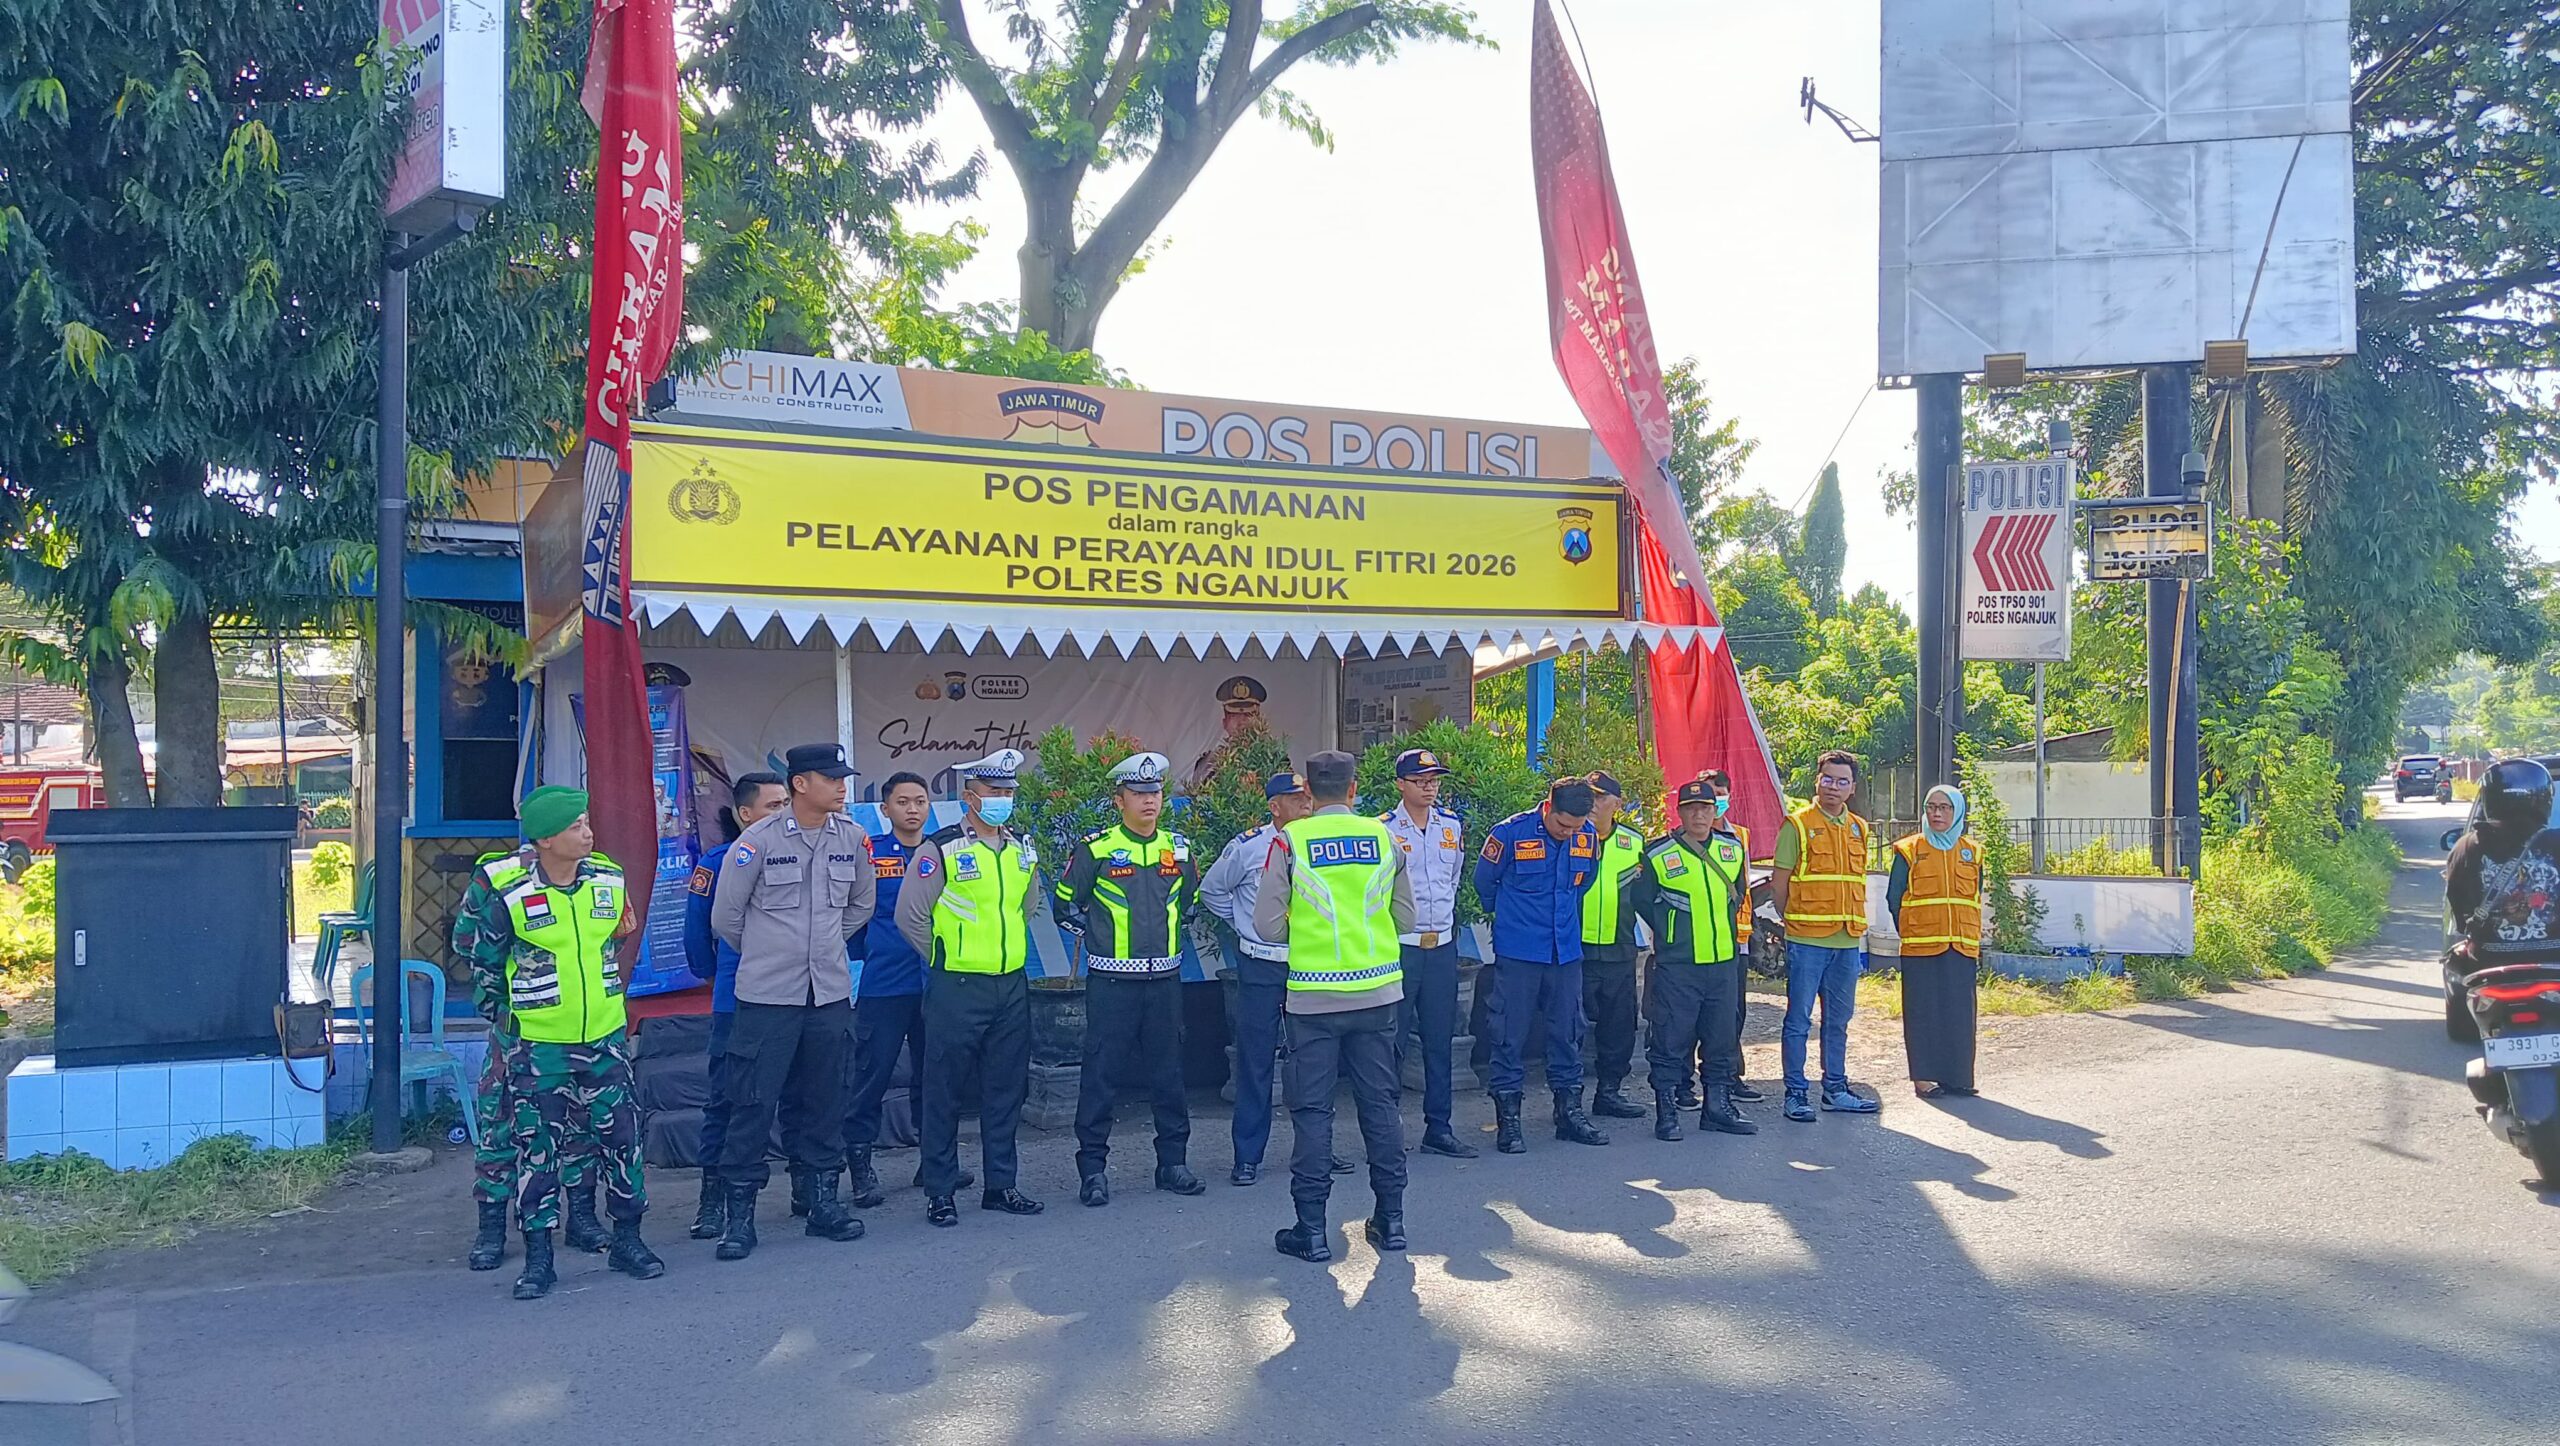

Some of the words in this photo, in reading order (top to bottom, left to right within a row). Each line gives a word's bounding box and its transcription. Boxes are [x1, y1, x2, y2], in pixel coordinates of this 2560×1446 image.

[677, 387, 737, 402] CHITECT
[742, 396, 771, 405] AND
[776, 397, 884, 414] CONSTRUCTION
[1006, 394, 1048, 411] JAWA
[1051, 394, 1099, 418] TIMUR
[1162, 407, 1308, 464] POS
[1331, 420, 1538, 478] POLISI
[984, 473, 1072, 505] POS
[1088, 479, 1365, 521] PENGAMANAN
[1968, 464, 2065, 511] POLISI
[1108, 513, 1176, 533] dalam
[1184, 519, 1259, 541] rangka
[787, 521, 1038, 559] PELAYANAN
[1054, 535, 1253, 568] PERAYAAN
[1266, 546, 1344, 572] IDUL
[1356, 550, 1435, 575] FITRI
[1447, 553, 1516, 577] 2026
[1007, 564, 1163, 593] POLRES
[1176, 572, 1349, 600] NGANJUK
[1977, 595, 1997, 609] POS
[2001, 595, 2026, 609] TPSO
[2028, 595, 2046, 609] 901
[1967, 611, 2005, 625] POLRES
[2007, 611, 2057, 625] NGANJUK
[981, 679, 1020, 687] POLRES
[981, 688, 1020, 696] NGANJUK
[878, 717, 1003, 760] Selamat
[828, 854, 854, 862] POLRI
[1310, 840, 1379, 863] POLISI
[593, 910, 616, 918] TNI-AD
[2487, 1041, 2496, 1052] W
[2508, 1038, 2540, 1051] 3931
